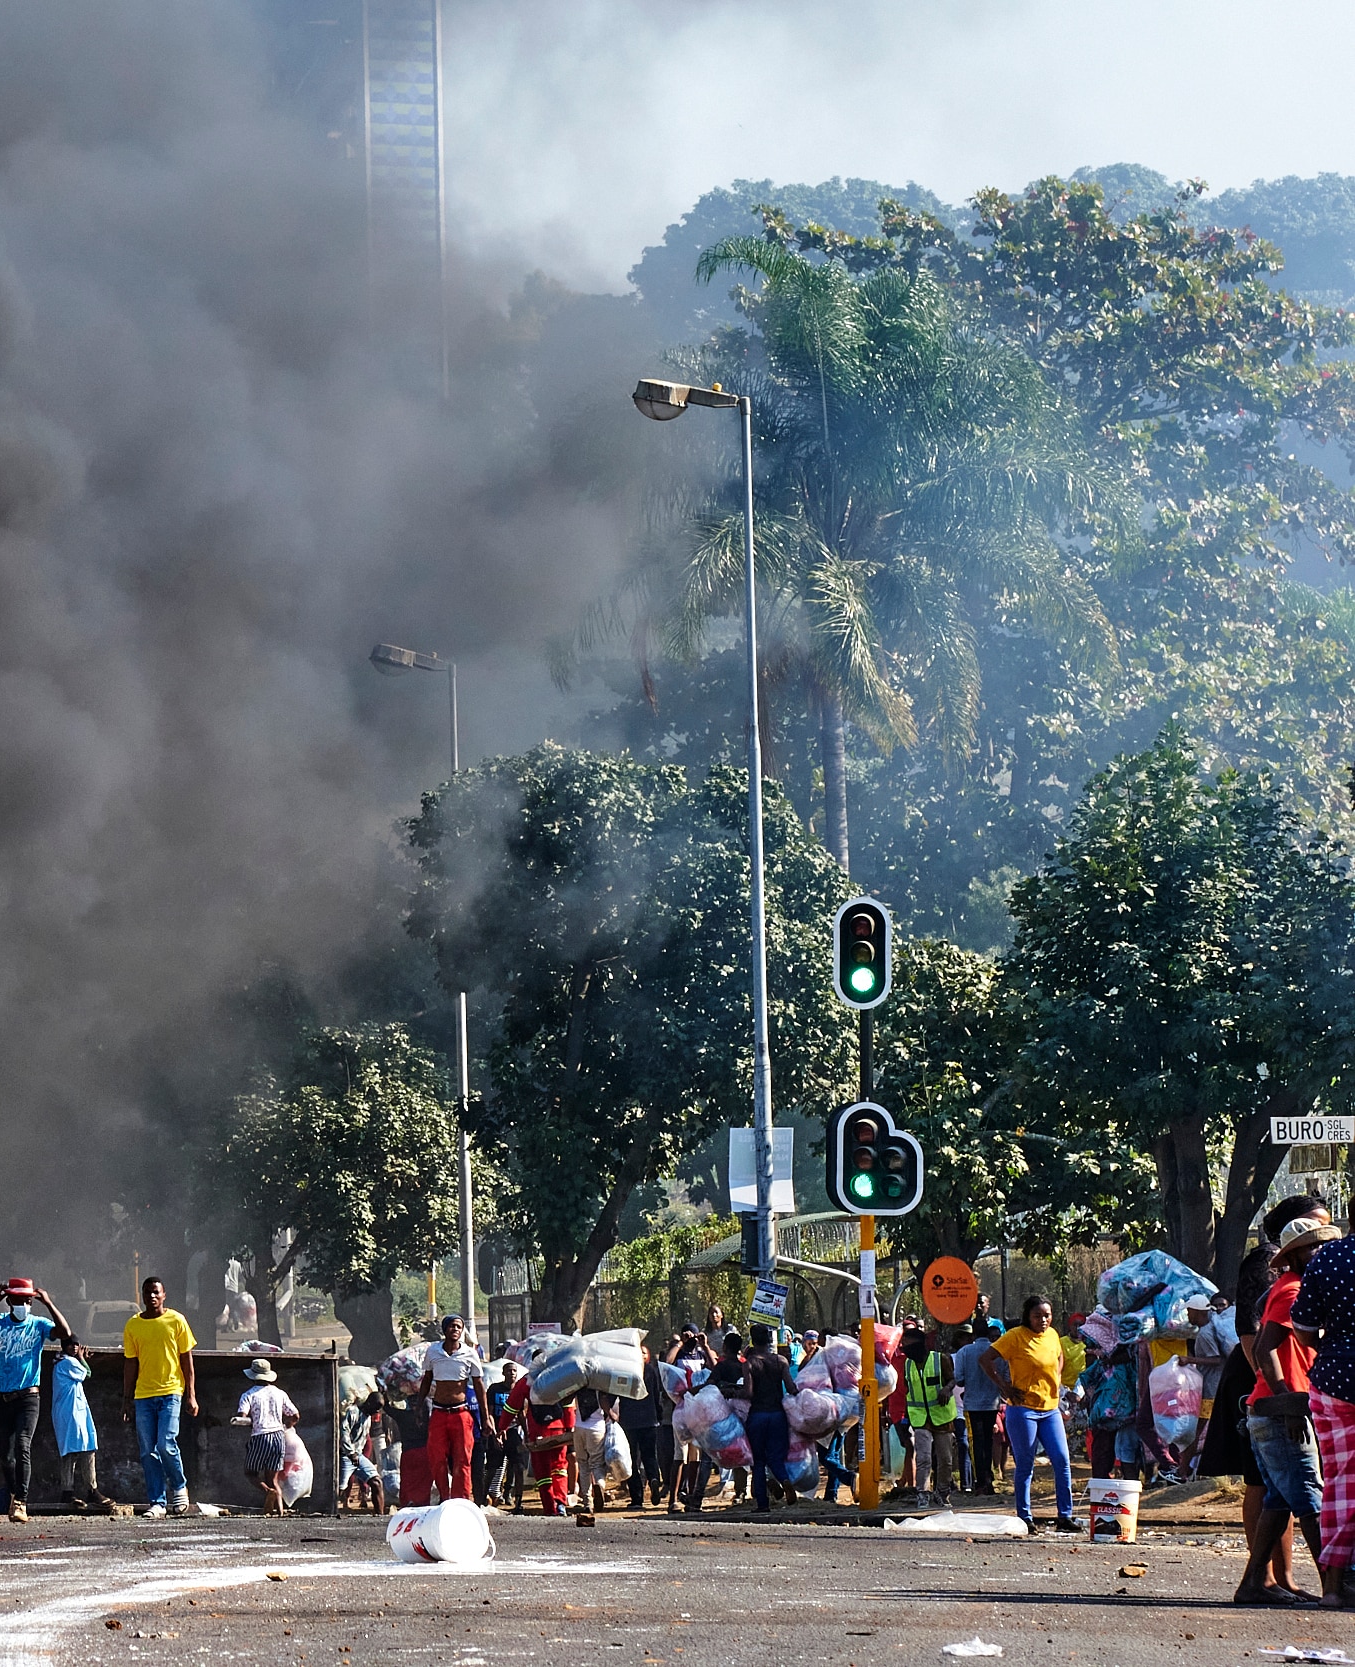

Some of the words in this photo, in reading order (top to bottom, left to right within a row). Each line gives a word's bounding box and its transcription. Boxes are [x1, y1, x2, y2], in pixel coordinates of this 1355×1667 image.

[1327, 1120, 1346, 1130] SGL
[1276, 1121, 1324, 1140] BURO
[1327, 1131, 1351, 1141] CRES
[1097, 1506, 1123, 1514] CLASSIC
